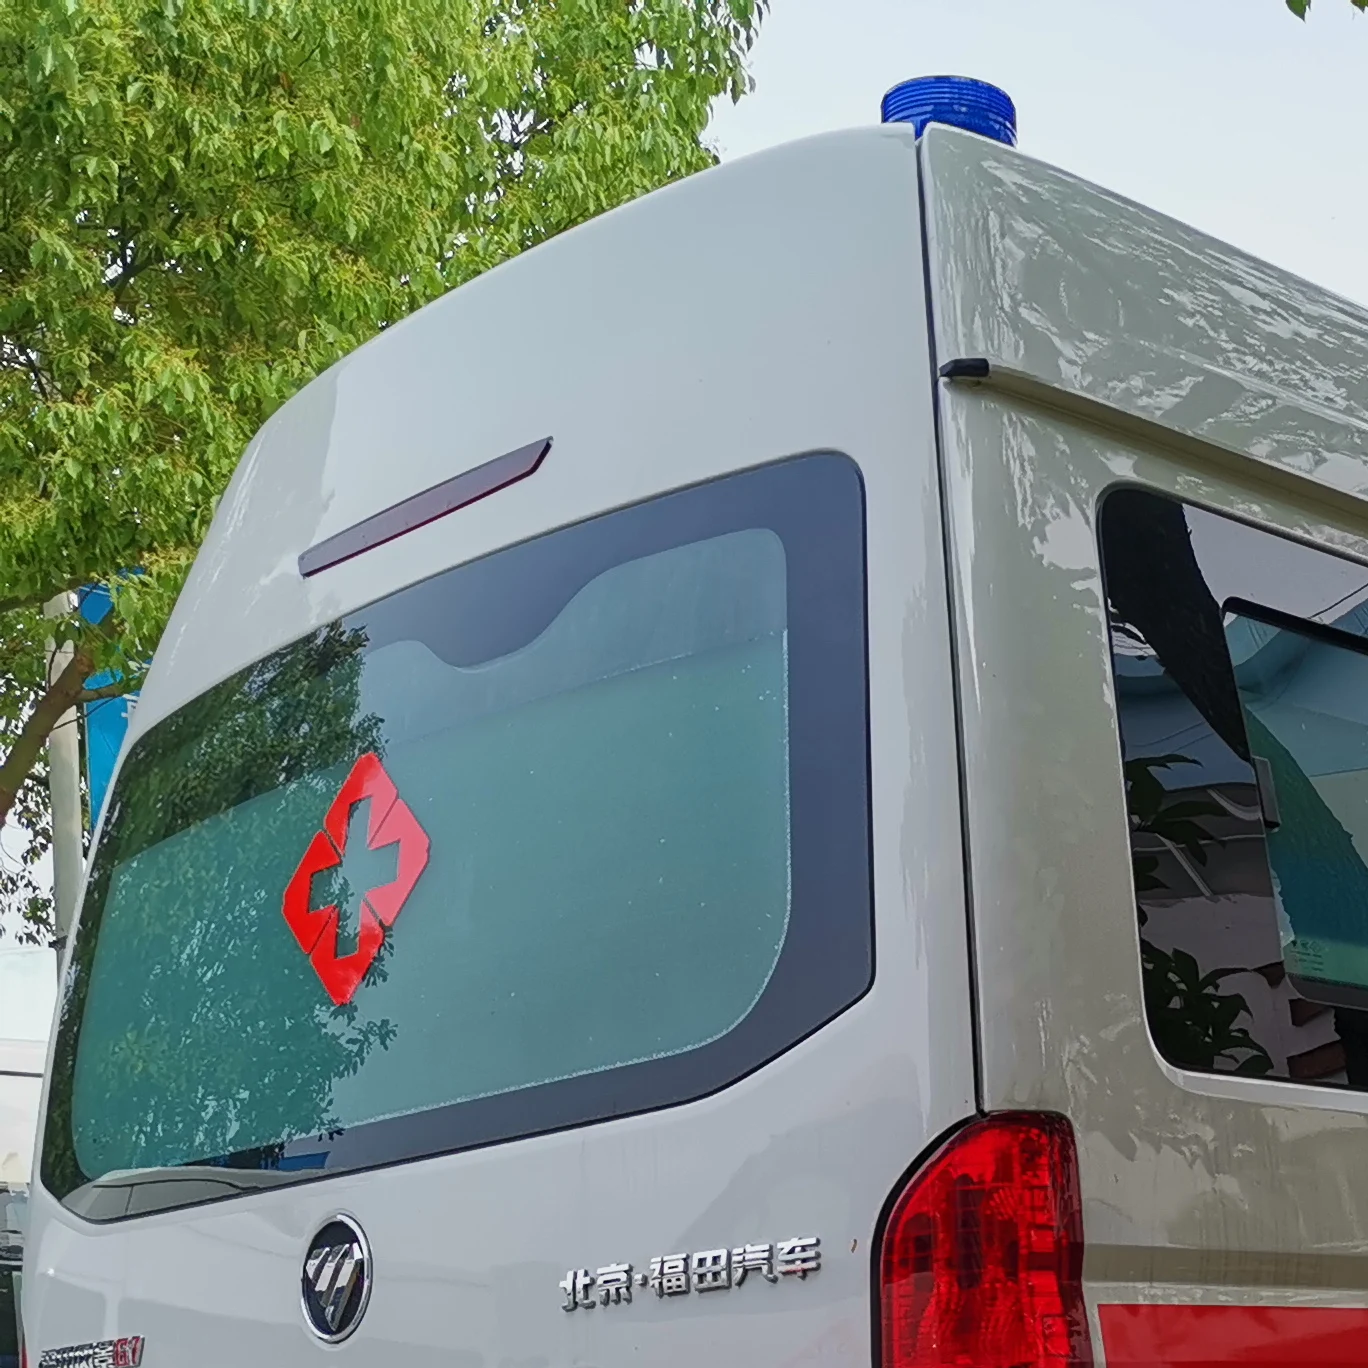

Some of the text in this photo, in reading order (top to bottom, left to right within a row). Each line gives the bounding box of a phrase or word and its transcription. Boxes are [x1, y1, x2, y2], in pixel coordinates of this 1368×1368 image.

[558, 1236, 822, 1312] 北京·福田汽车
